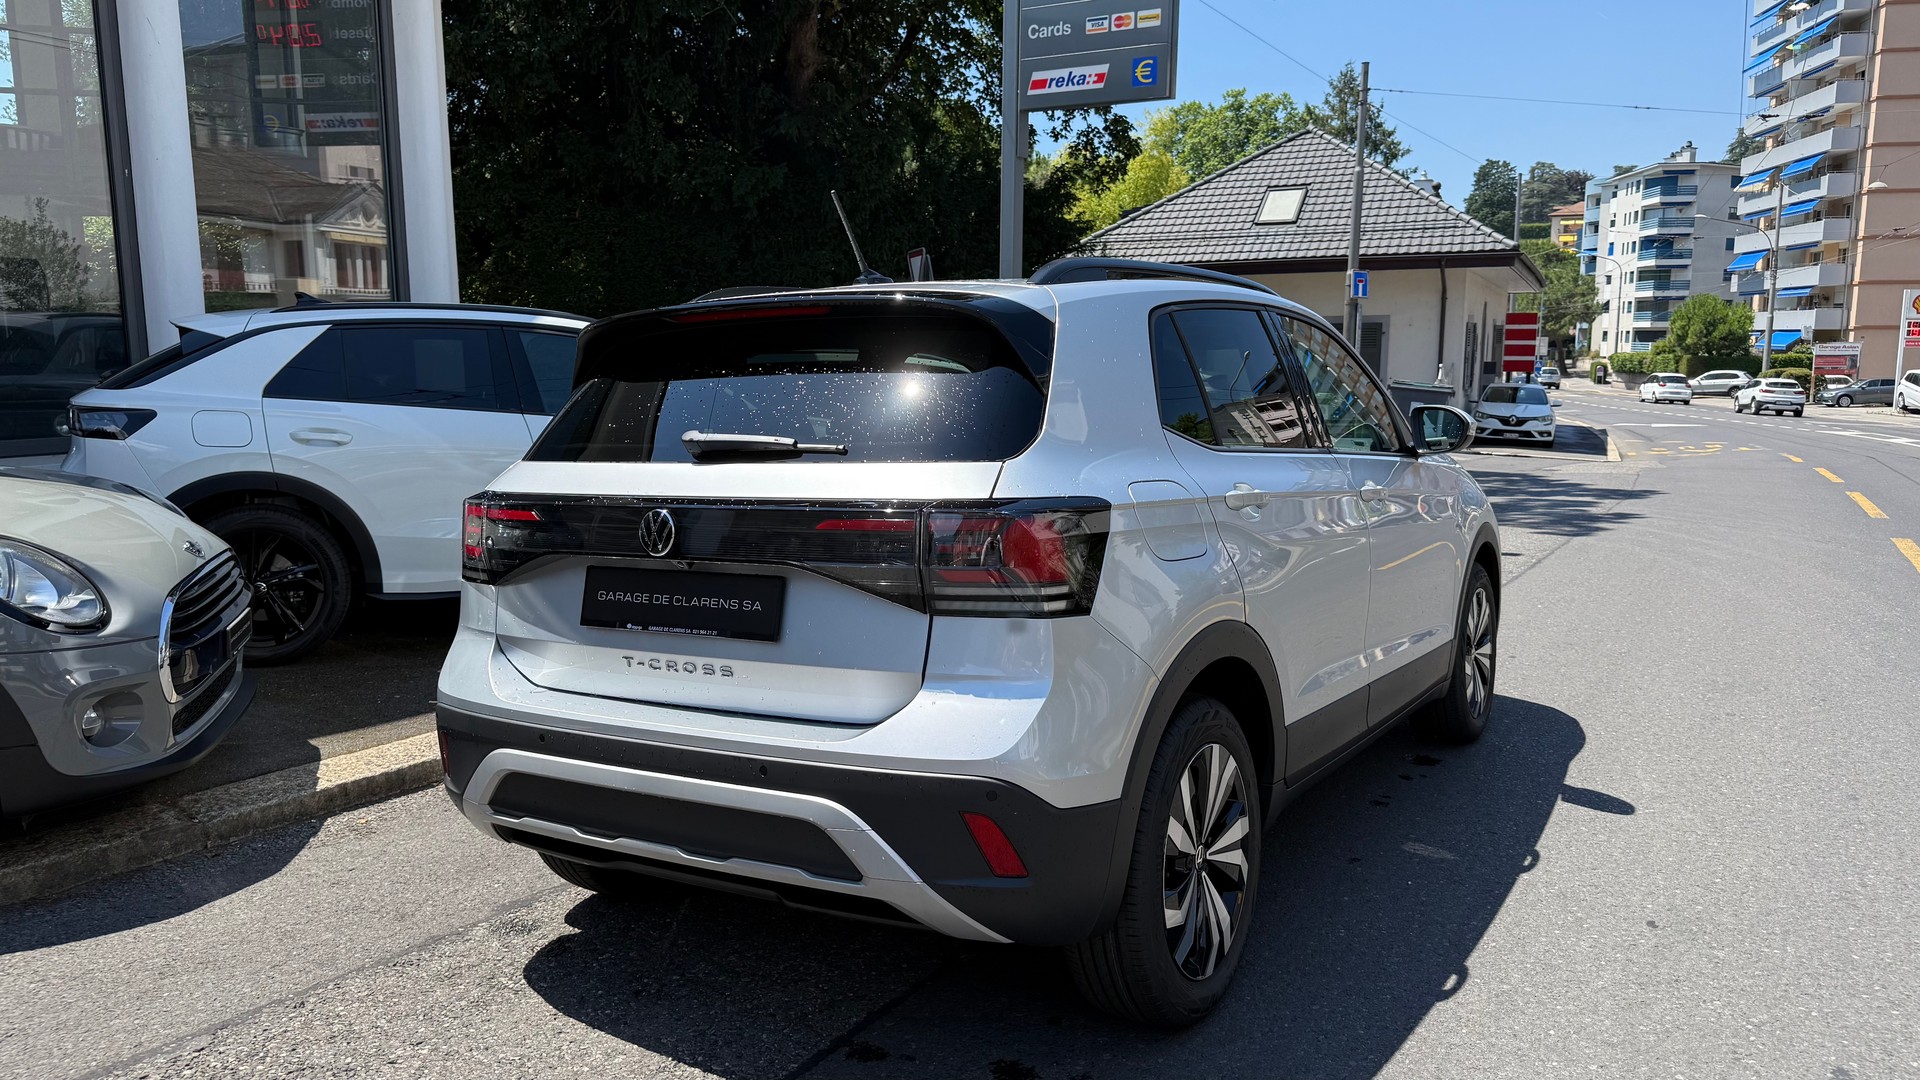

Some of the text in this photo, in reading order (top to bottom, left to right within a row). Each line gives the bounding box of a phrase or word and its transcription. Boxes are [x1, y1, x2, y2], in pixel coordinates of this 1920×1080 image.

[1028, 21, 1071, 39] Cards
[597, 590, 762, 611] GARAGE DE CLARENS SA
[621, 656, 734, 678] T-CROSS
